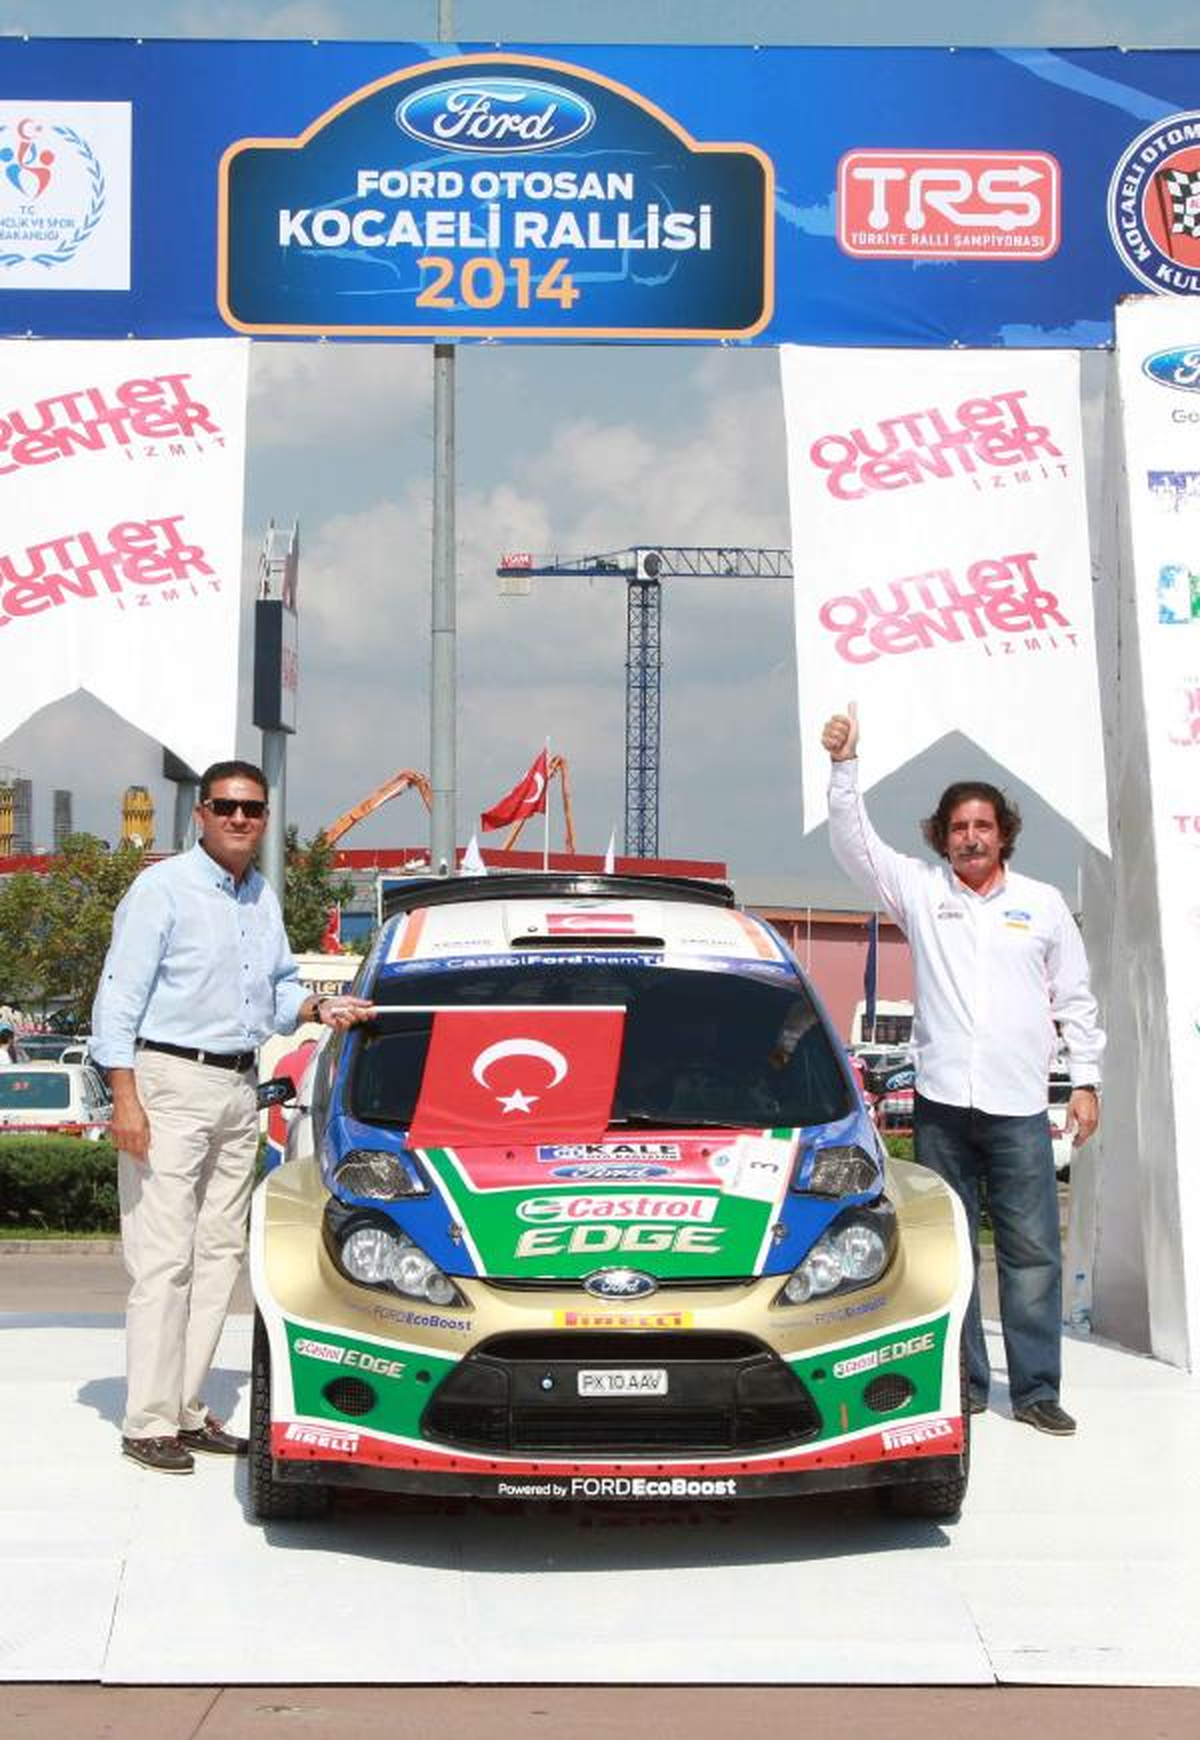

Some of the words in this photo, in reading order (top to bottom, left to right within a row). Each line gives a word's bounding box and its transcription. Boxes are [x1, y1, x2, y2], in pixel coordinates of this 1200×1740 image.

[433, 87, 557, 140] Ford
[357, 170, 464, 199] FORD
[471, 171, 634, 201] OTOSAN
[852, 165, 1045, 231] TRS
[279, 198, 502, 250] KOCAELİ
[514, 204, 712, 250] RALLİSİ
[851, 231, 907, 247] TÜRKİYE
[910, 232, 949, 247] RALLİ
[415, 256, 580, 310] 2014
[585, 1144, 678, 1155] KALE
[567, 1197, 704, 1219] Castrol
[513, 1224, 729, 1258] EDGE
[601, 1275, 641, 1294] Ford
[879, 1332, 936, 1363] EDGE
[342, 1351, 407, 1378] EDGE
[285, 1423, 361, 1453] PIRELLI
[881, 1420, 953, 1450] PIRELLI
[498, 1483, 551, 1495] Powered
[553, 1484, 568, 1497] by
